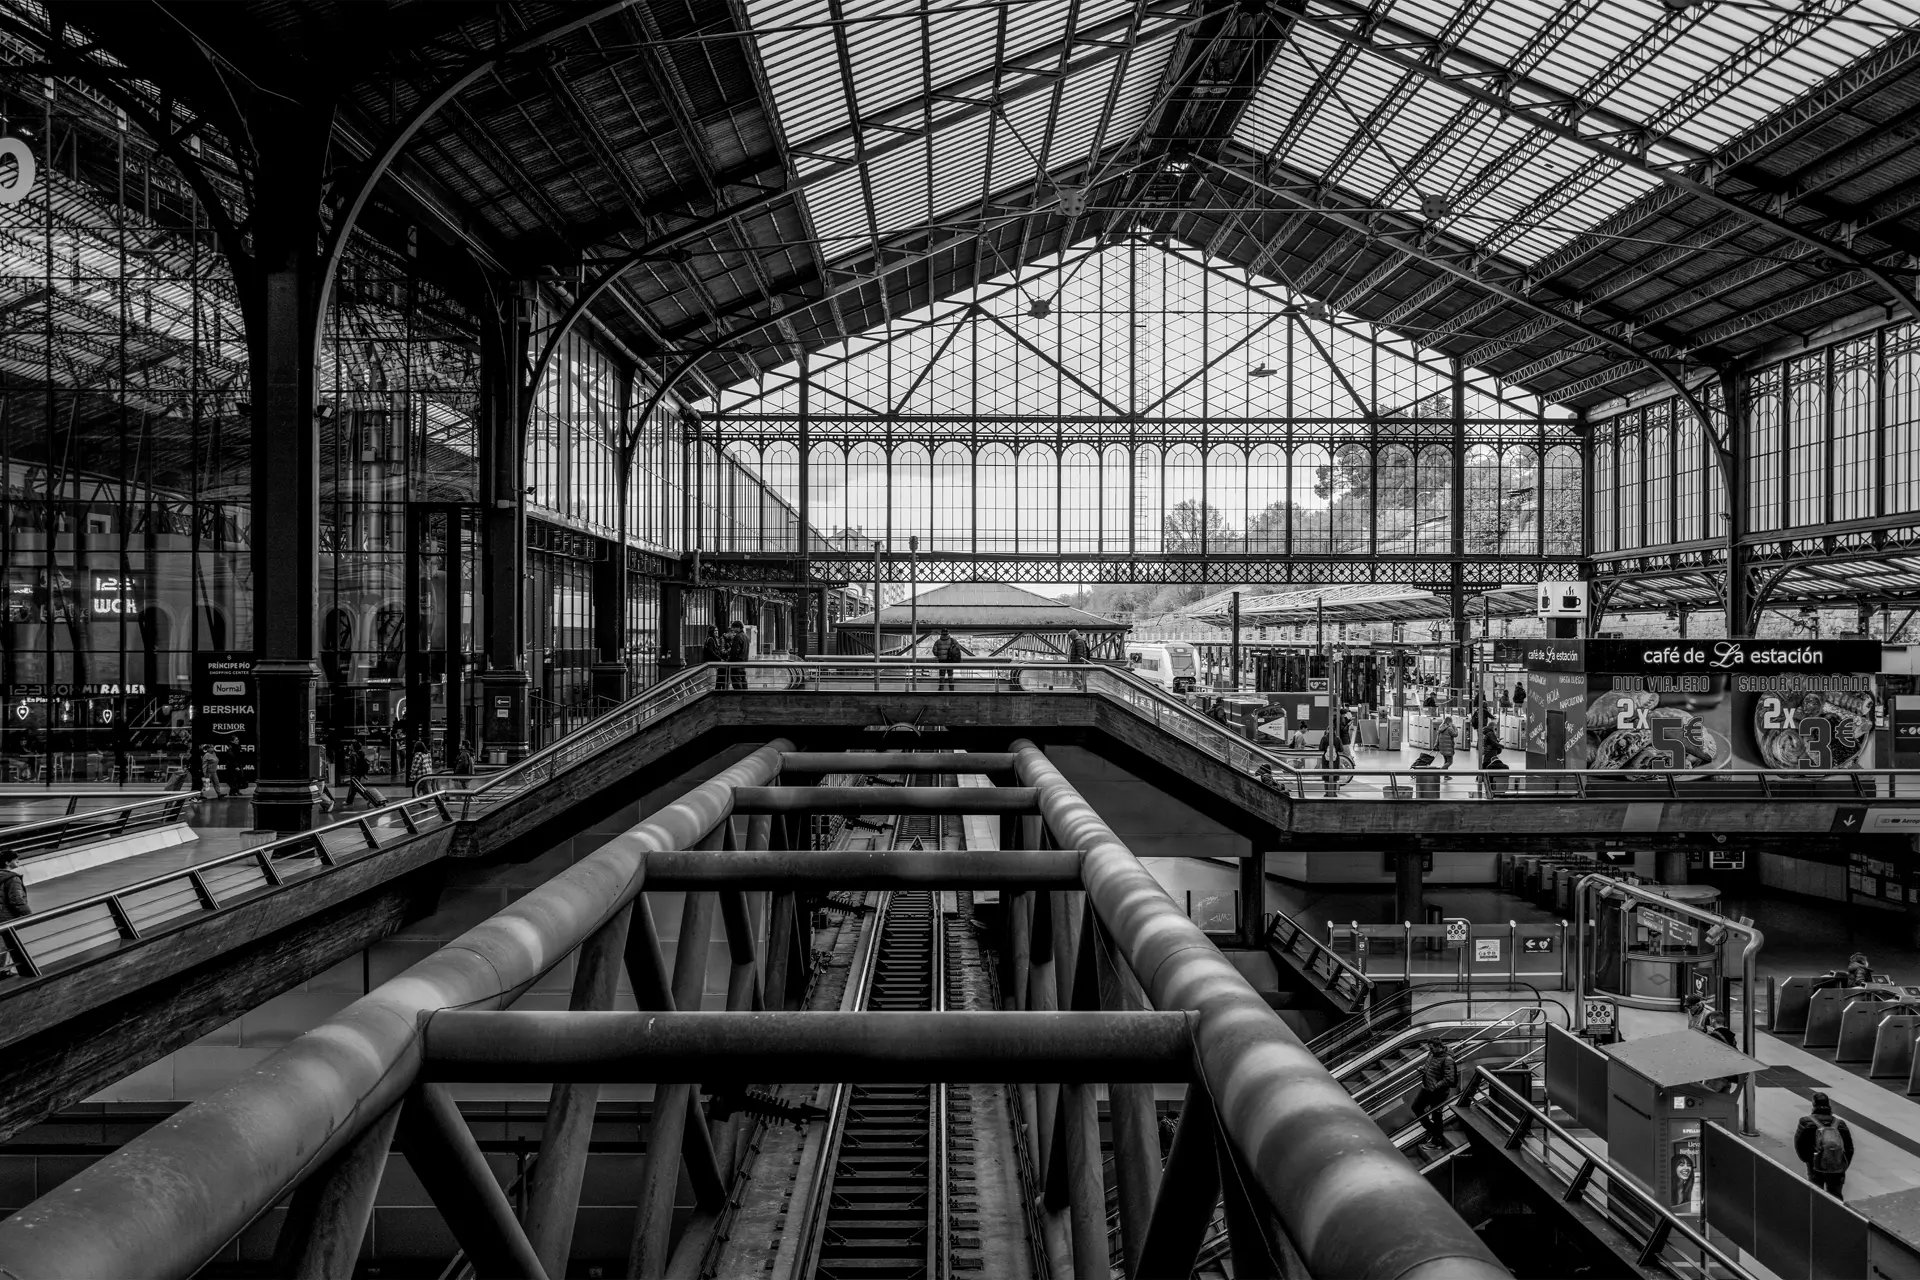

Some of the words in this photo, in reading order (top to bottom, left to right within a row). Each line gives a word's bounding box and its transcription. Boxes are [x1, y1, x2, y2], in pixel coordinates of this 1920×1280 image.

[1556, 650, 1578, 661] estación
[1643, 647, 1680, 663] café
[1684, 648, 1705, 663] de
[1709, 642, 1744, 668] La
[1750, 646, 1824, 664] estación
[208, 661, 238, 669] PRÍNCIPE
[239, 661, 250, 669] PÍO
[217, 684, 242, 692] Normal
[1612, 676, 1643, 692] DUO
[1647, 676, 1710, 692] VIAJERO
[1739, 676, 1788, 692] SABOR
[1792, 676, 1802, 692] A
[1806, 674, 1870, 692] MAÑANA
[203, 705, 256, 714] BERSHKA
[1617, 698, 1649, 729] 2x
[1764, 698, 1796, 729] 2x
